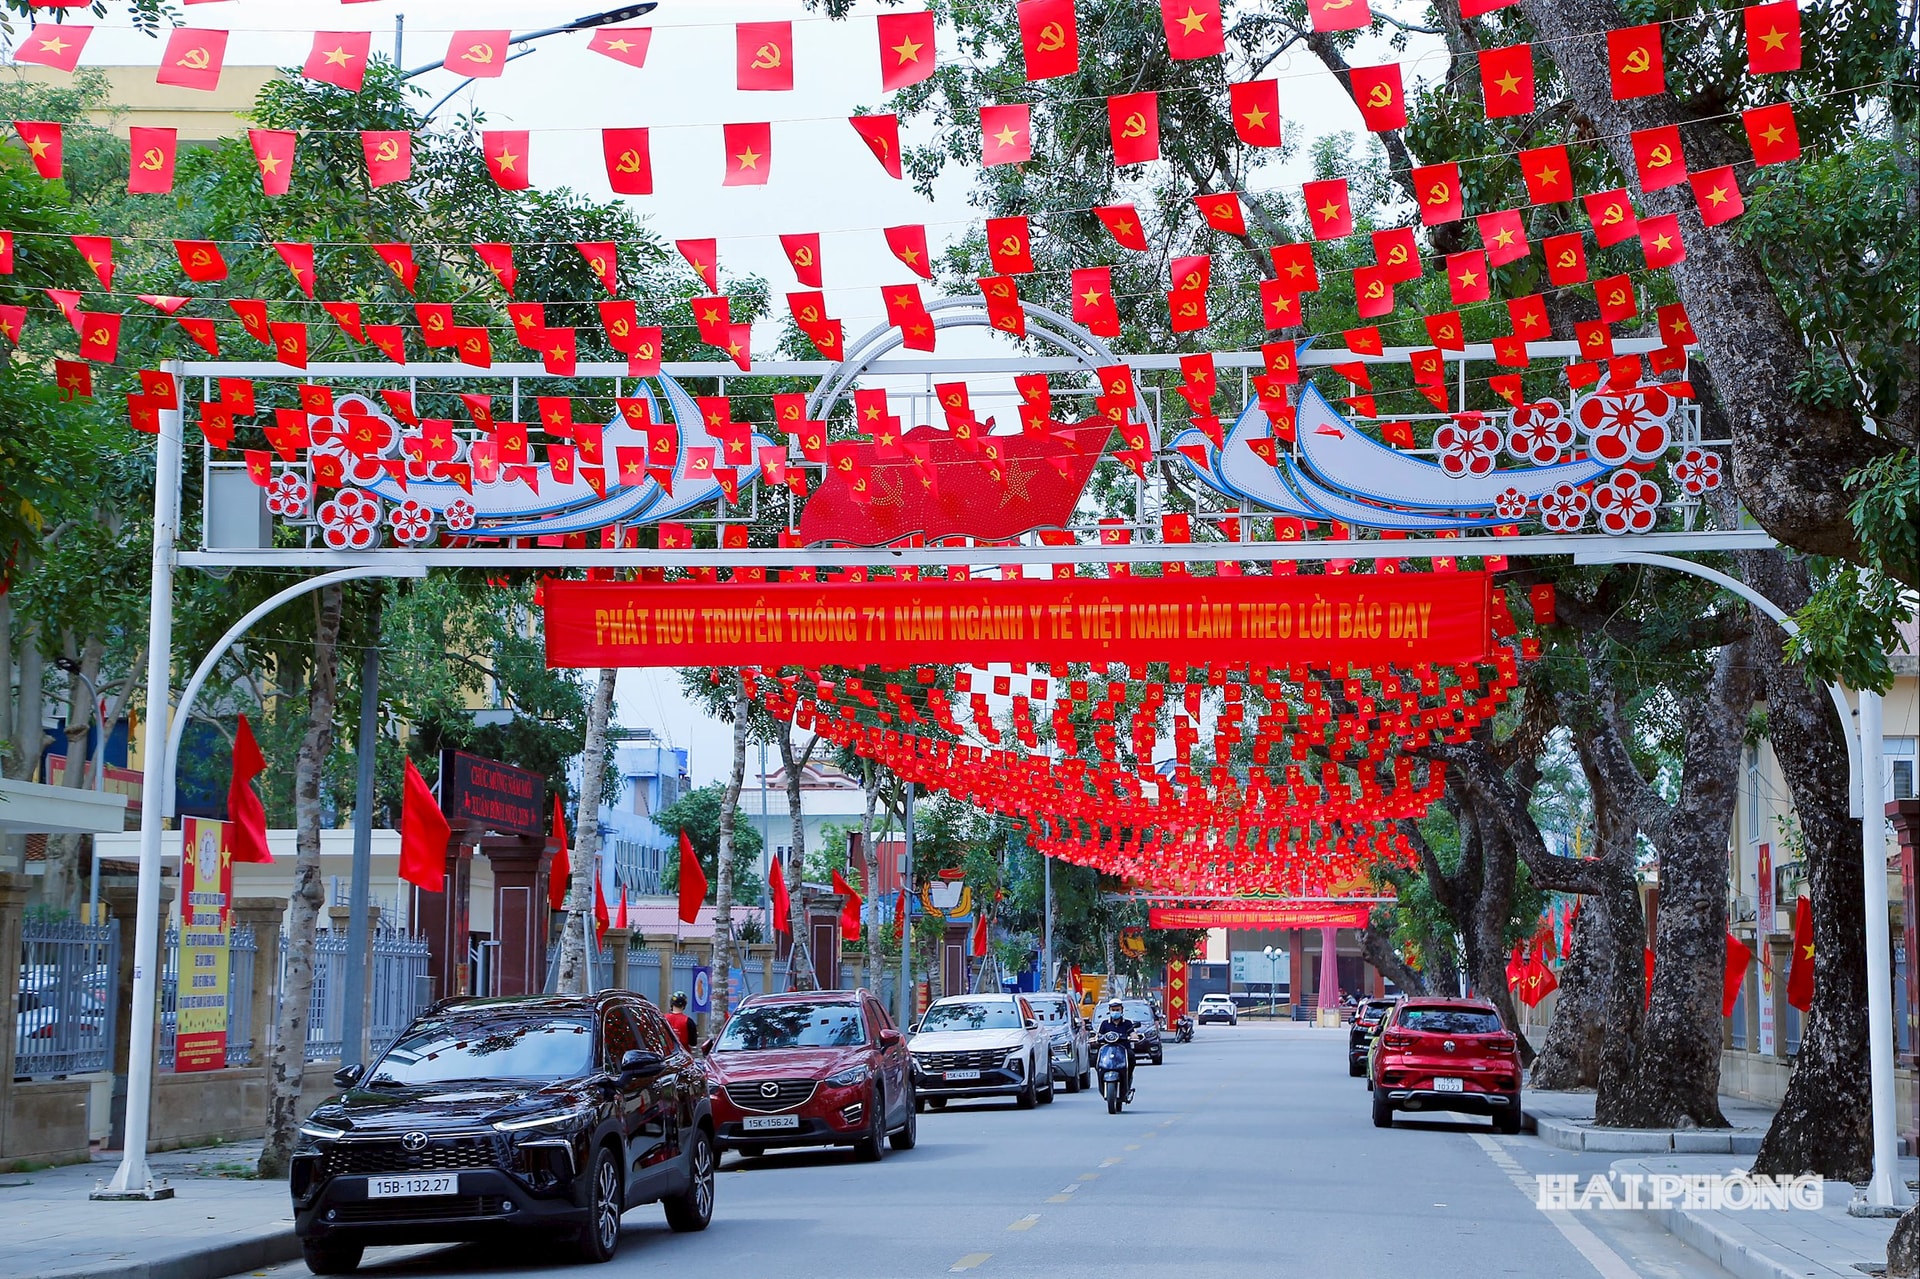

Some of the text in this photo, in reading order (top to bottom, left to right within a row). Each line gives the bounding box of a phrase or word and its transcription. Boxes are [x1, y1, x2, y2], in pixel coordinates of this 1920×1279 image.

[595, 593, 1432, 648] PHÁT HUY TRUYỀN THỐNG 71 NĂM NGÀNH Y TẾ VIỆT NAM LÀM THEO LỜI BÁC DẠY
[471, 763, 489, 787] CHÚC
[748, 1118, 794, 1128] 15K-156.24
[377, 1178, 450, 1194] 15B-132.27
